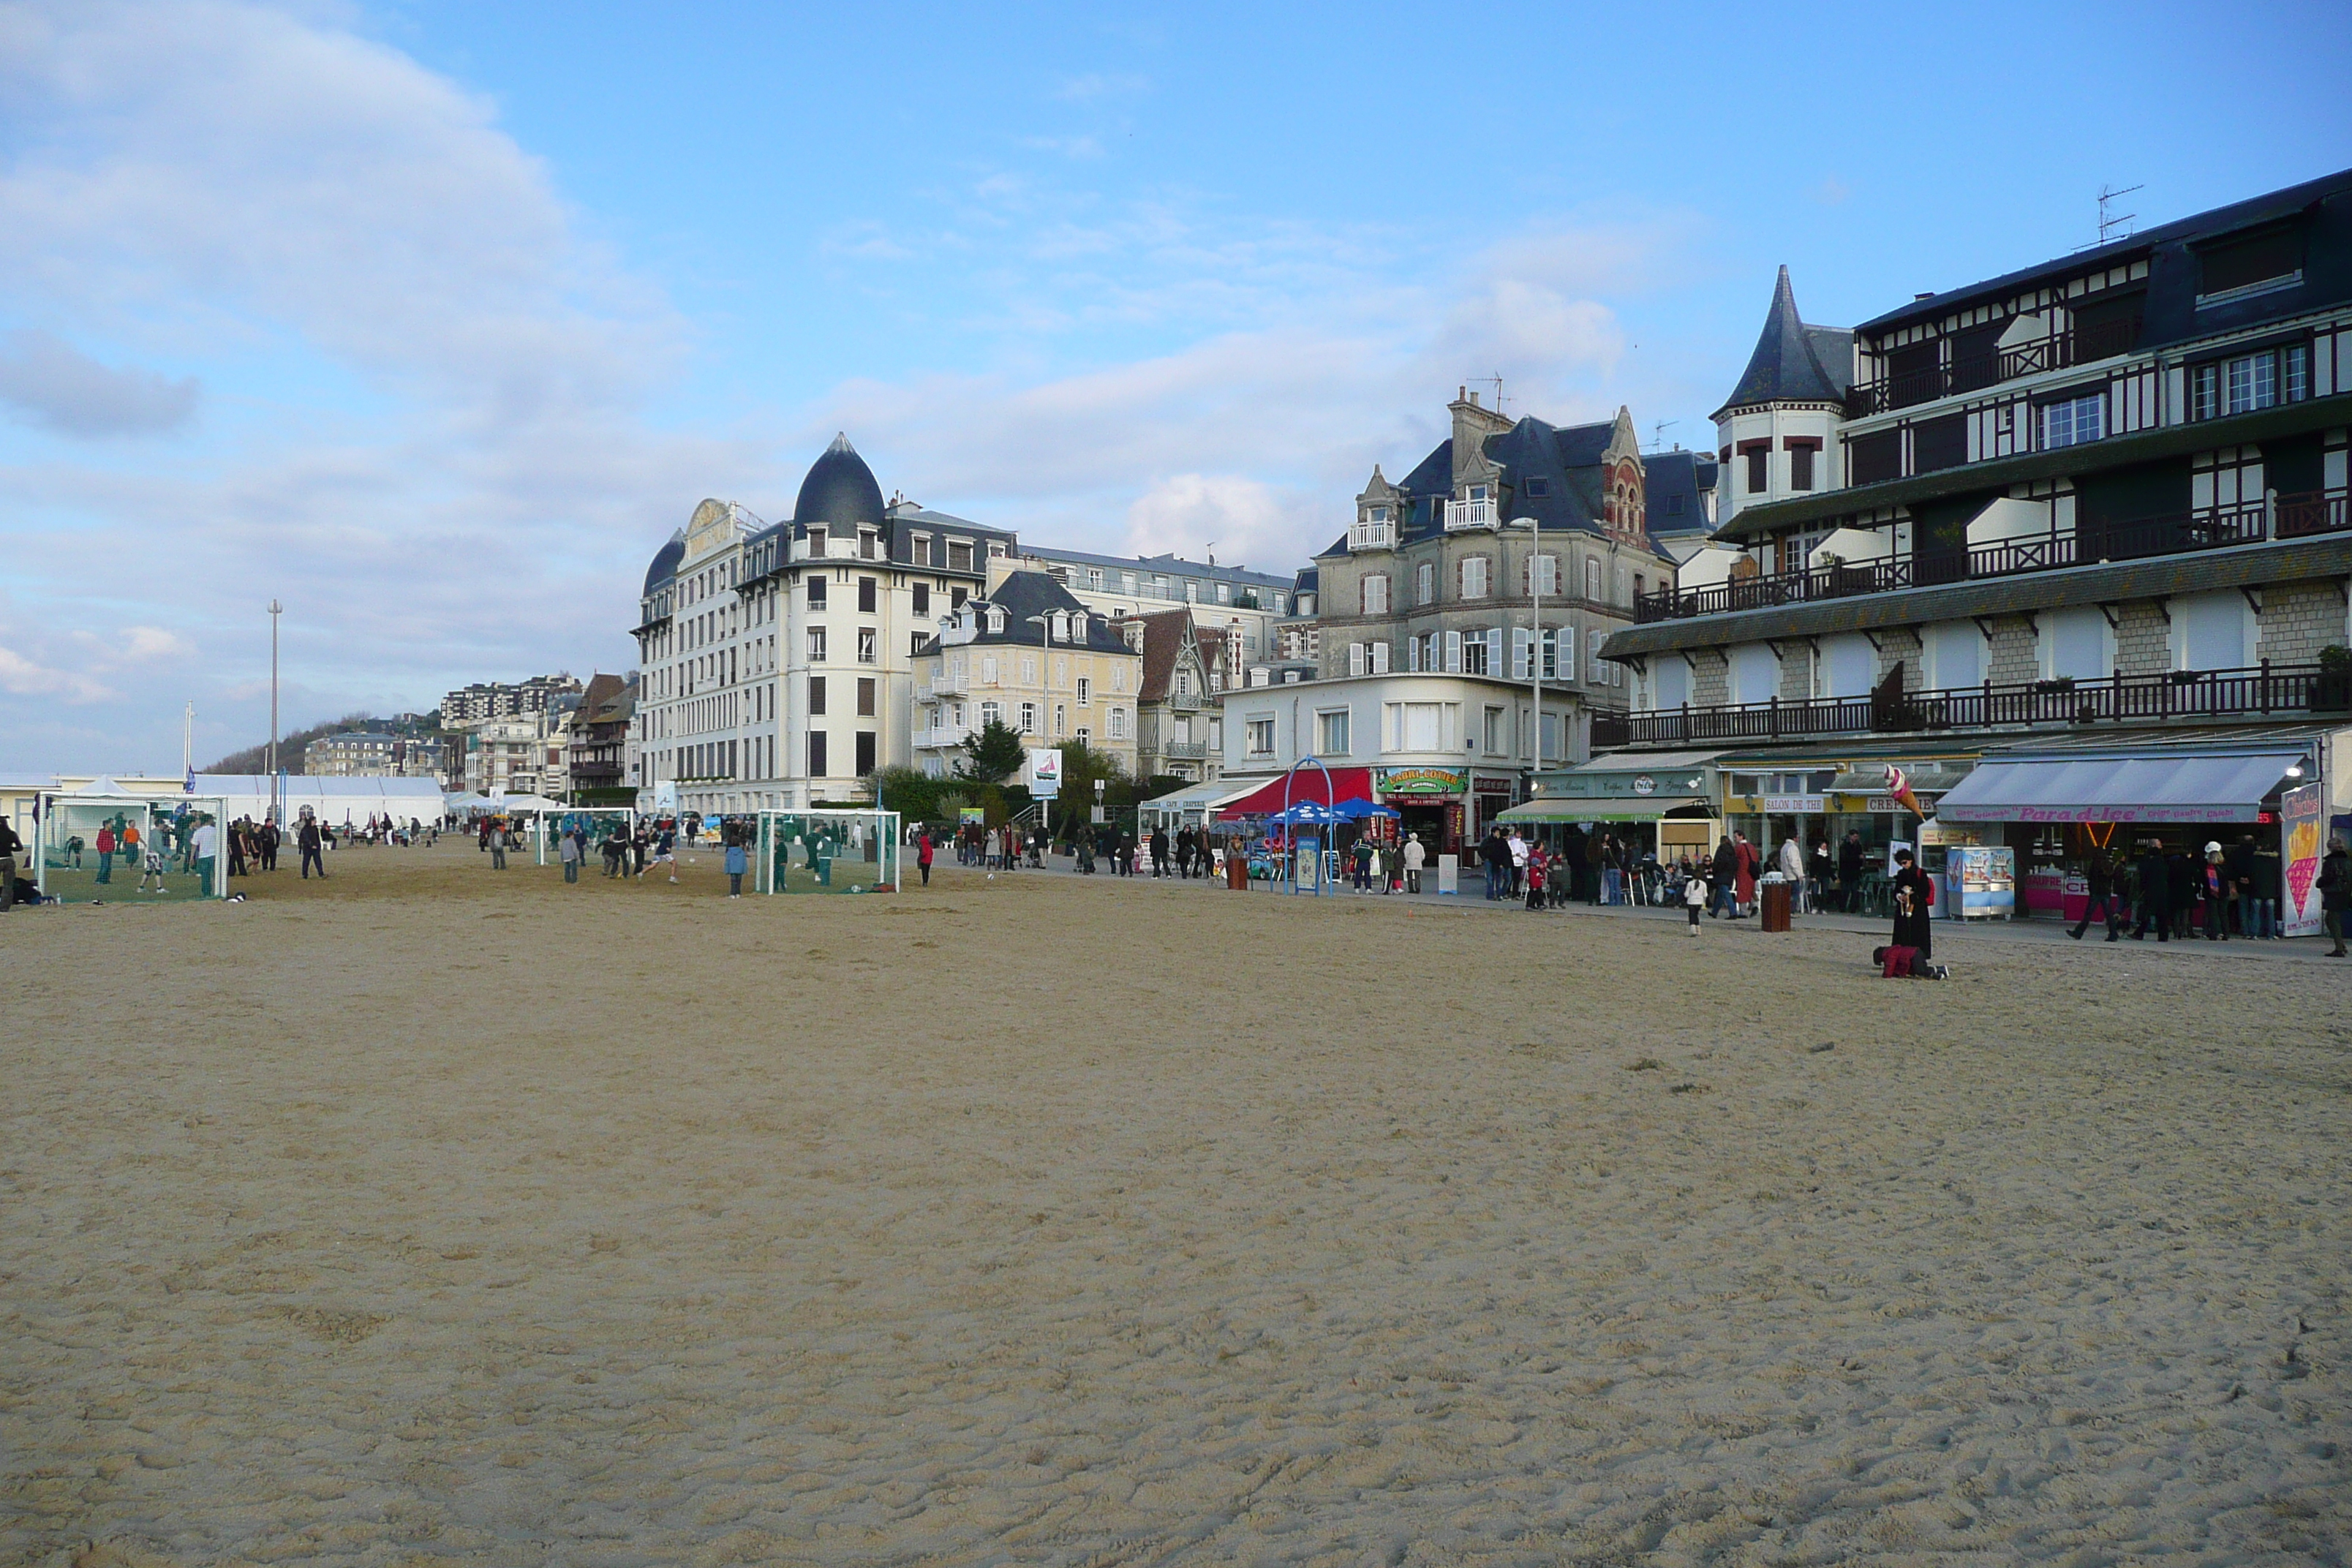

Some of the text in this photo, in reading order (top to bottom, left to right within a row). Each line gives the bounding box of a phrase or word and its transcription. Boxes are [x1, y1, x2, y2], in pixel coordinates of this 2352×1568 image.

[1389, 769, 1458, 785] L'ABRI-COTIER
[1765, 799, 1822, 810] SALON DE THE
